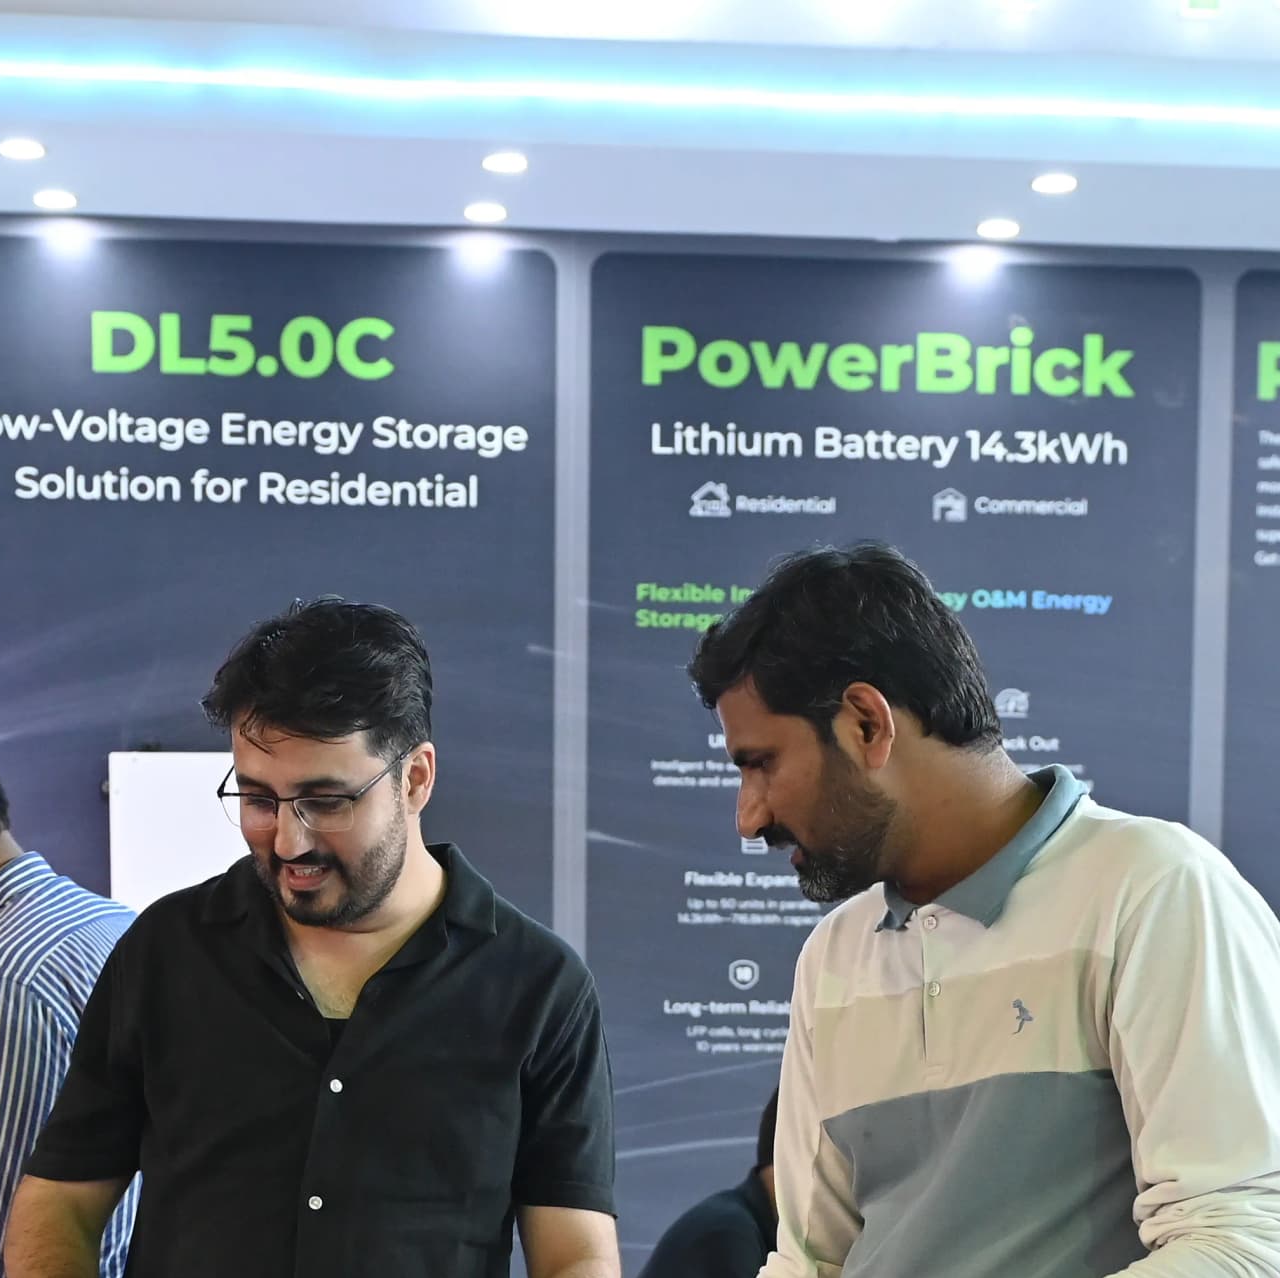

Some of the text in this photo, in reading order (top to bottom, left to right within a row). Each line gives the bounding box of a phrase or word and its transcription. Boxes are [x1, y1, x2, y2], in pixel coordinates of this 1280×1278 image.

[90, 310, 395, 380] DL5.0C
[643, 322, 1133, 397] PowerBrick
[222, 413, 363, 454] Energy
[373, 416, 528, 458] Storage
[652, 422, 1127, 468] Lithium Battery 14.3kWh
[15, 466, 477, 507] Solution for Residential
[736, 496, 836, 514] Residential
[974, 496, 1088, 515] Commercial
[637, 583, 725, 603] Flexible
[972, 590, 1026, 608] O&M
[1032, 591, 1112, 614] Energy
[684, 872, 743, 887] Flexible
[664, 999, 747, 1018] Long-term
